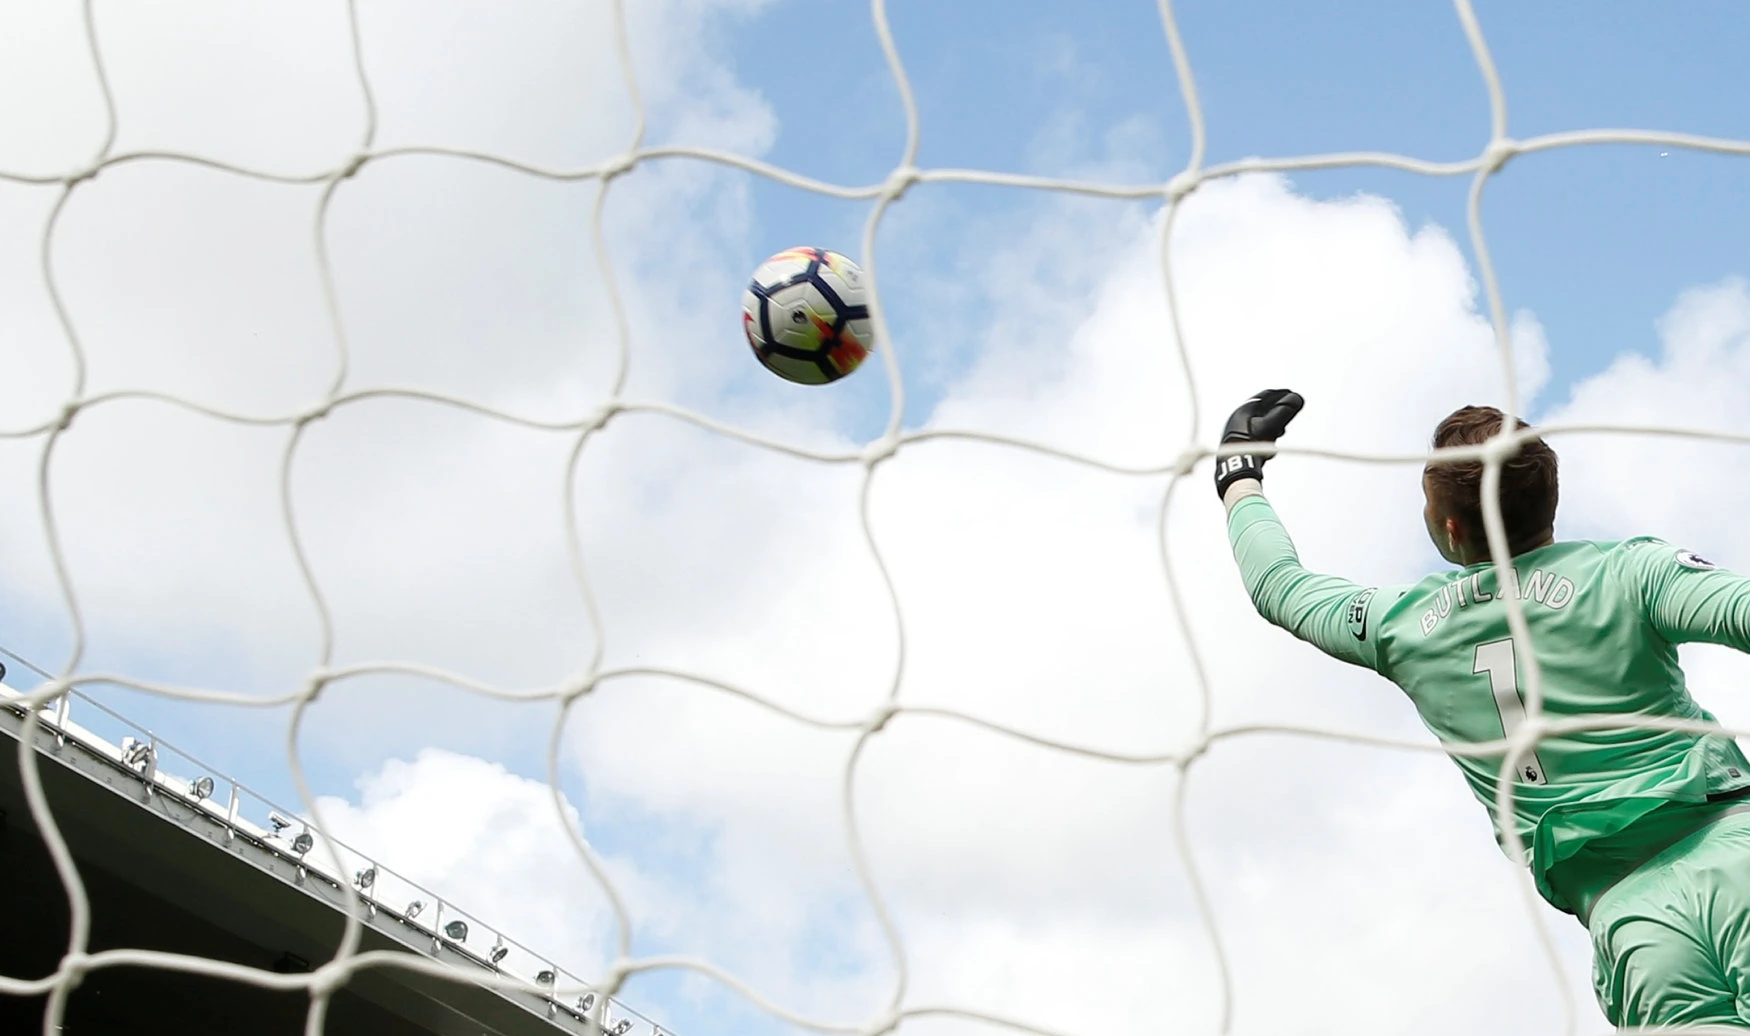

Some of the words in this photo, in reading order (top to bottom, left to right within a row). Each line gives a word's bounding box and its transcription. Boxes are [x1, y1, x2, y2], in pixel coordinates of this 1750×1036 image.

[1218, 454, 1255, 481] JB1
[1420, 567, 1574, 636] BUTLAND
[1473, 637, 1548, 785] 1
